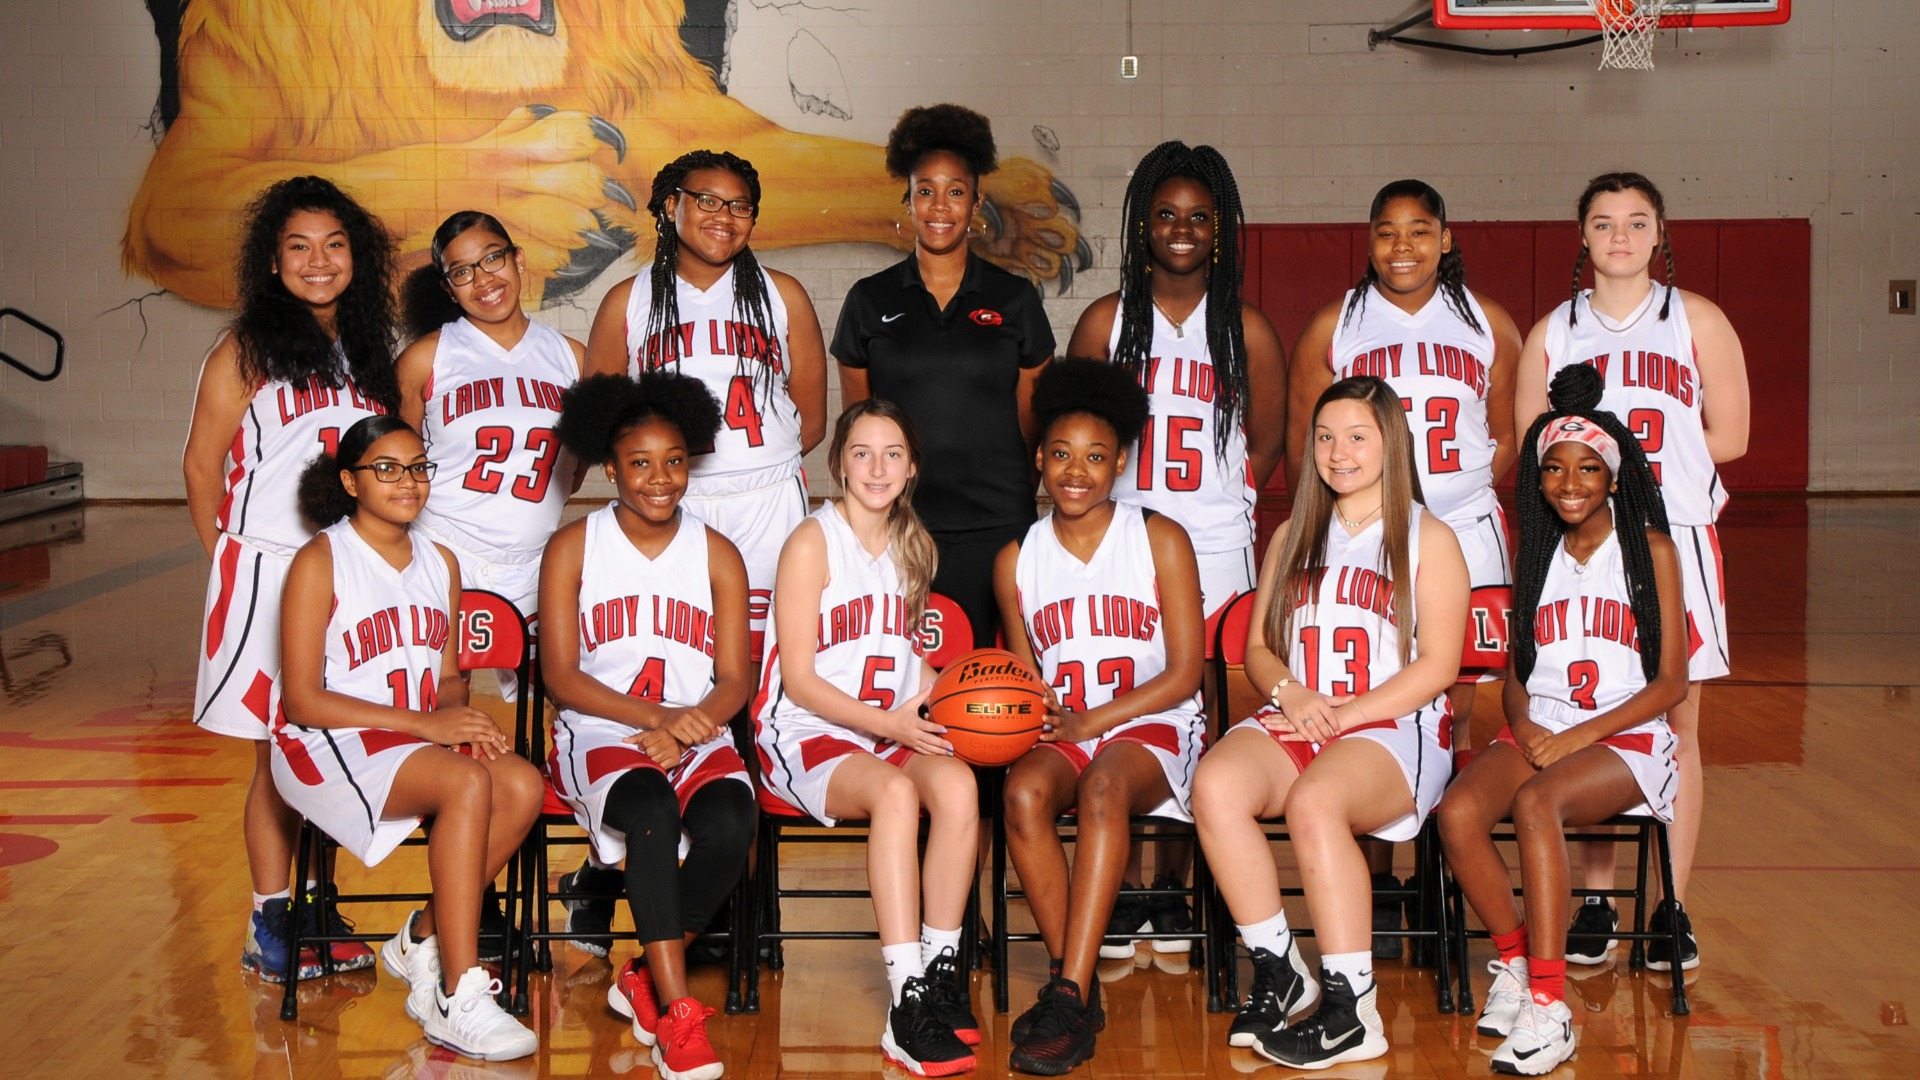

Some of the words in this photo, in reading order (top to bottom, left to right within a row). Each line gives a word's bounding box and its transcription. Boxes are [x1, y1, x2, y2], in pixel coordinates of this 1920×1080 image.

[1172, 357, 1226, 408] LIO
[1417, 342, 1486, 399] LIONS
[1623, 351, 1693, 408] LIONS
[442, 377, 504, 427] LADY
[516, 377, 565, 413] LIO
[462, 425, 562, 503] 23
[1136, 414, 1203, 492] 15
[343, 606, 404, 671] LADY
[581, 595, 639, 653] LADY
[817, 594, 873, 653] LADY
[1088, 594, 1158, 642] LIONS
[1580, 596, 1641, 653] LION
[858, 655, 895, 711] 5
[959, 661, 1035, 684] Baden
[1300, 626, 1370, 698] 13
[965, 703, 1032, 715] ELITE
